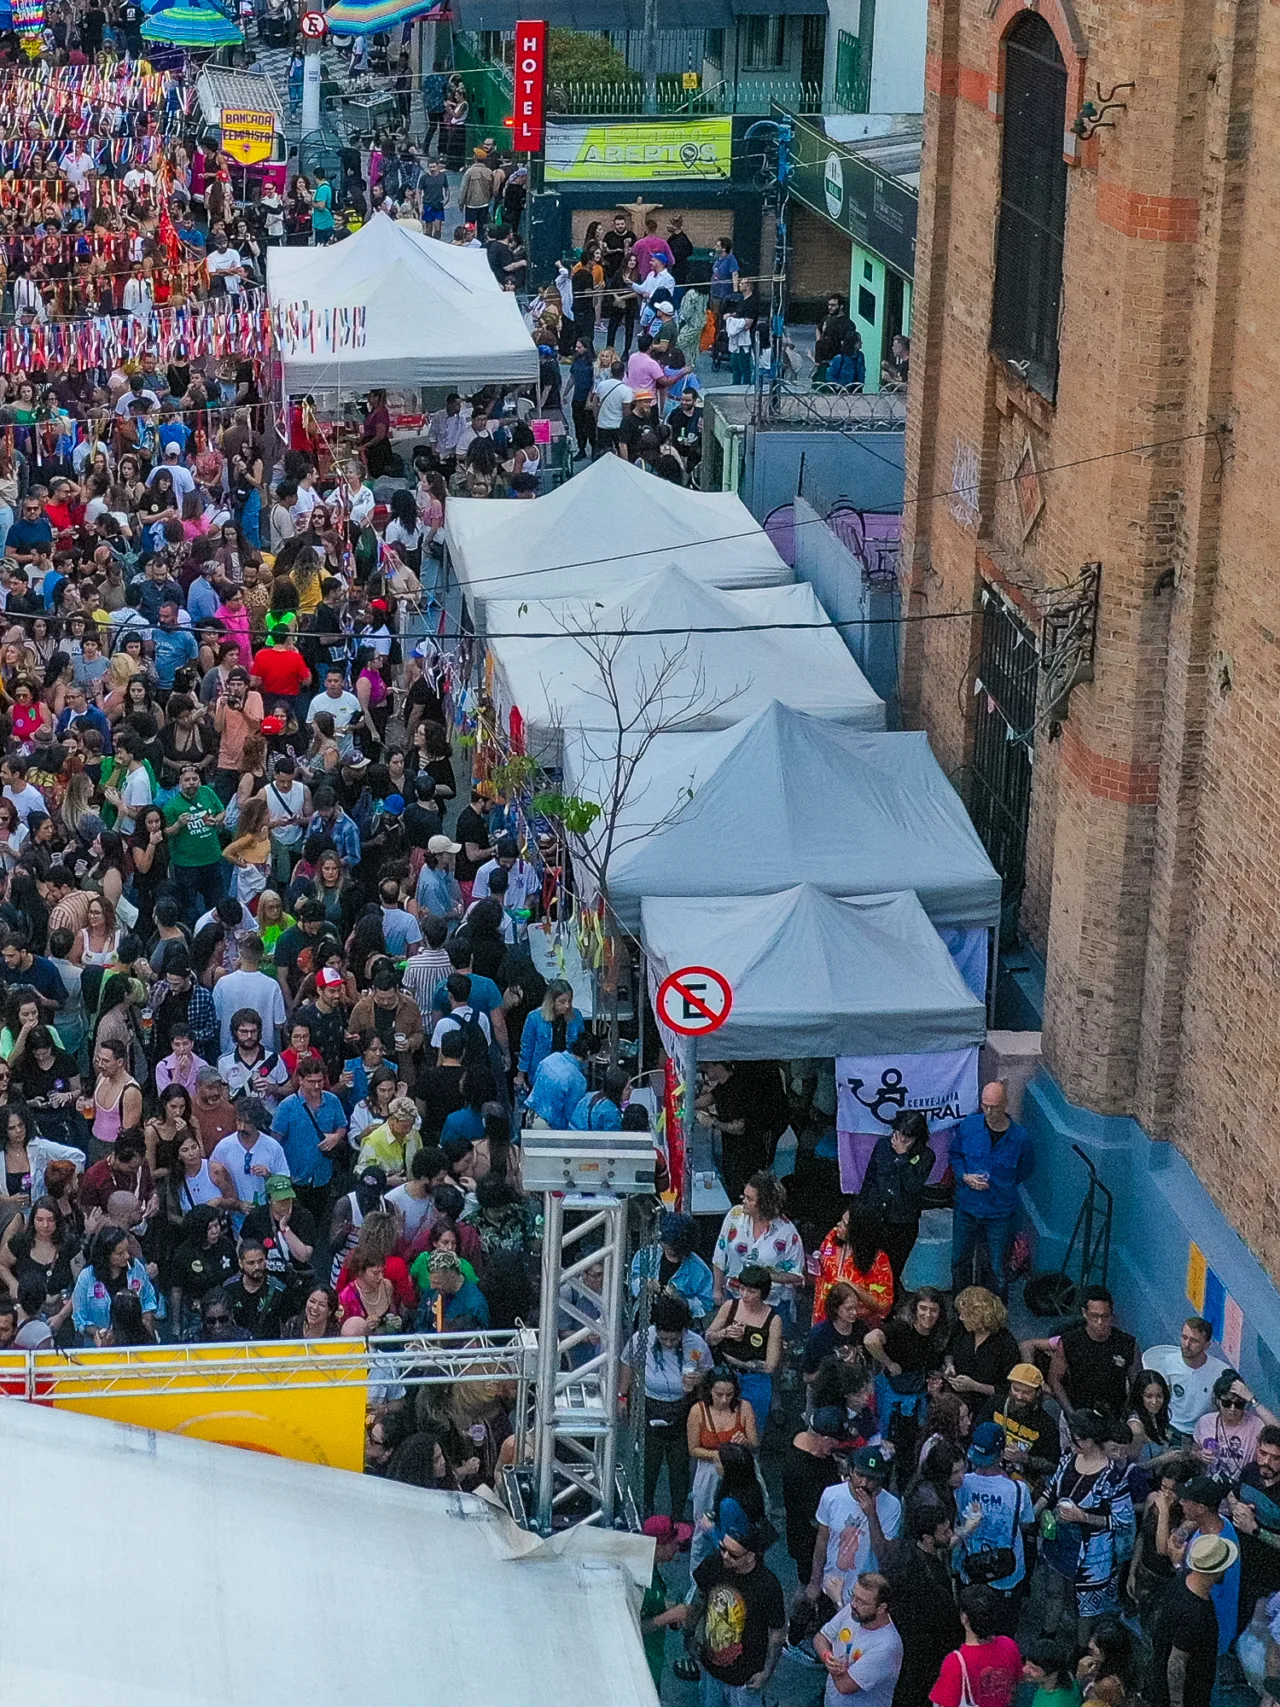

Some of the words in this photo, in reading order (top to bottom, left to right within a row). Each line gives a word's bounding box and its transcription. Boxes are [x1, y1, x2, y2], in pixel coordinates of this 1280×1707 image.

[522, 37, 537, 137] HOTEL
[225, 113, 273, 126] BANCADA
[223, 129, 271, 142] FEMINISTA
[584, 143, 717, 168] ABERTOS
[907, 1091, 960, 1108] CERVEJARIA
[971, 1492, 1002, 1507] NCM
